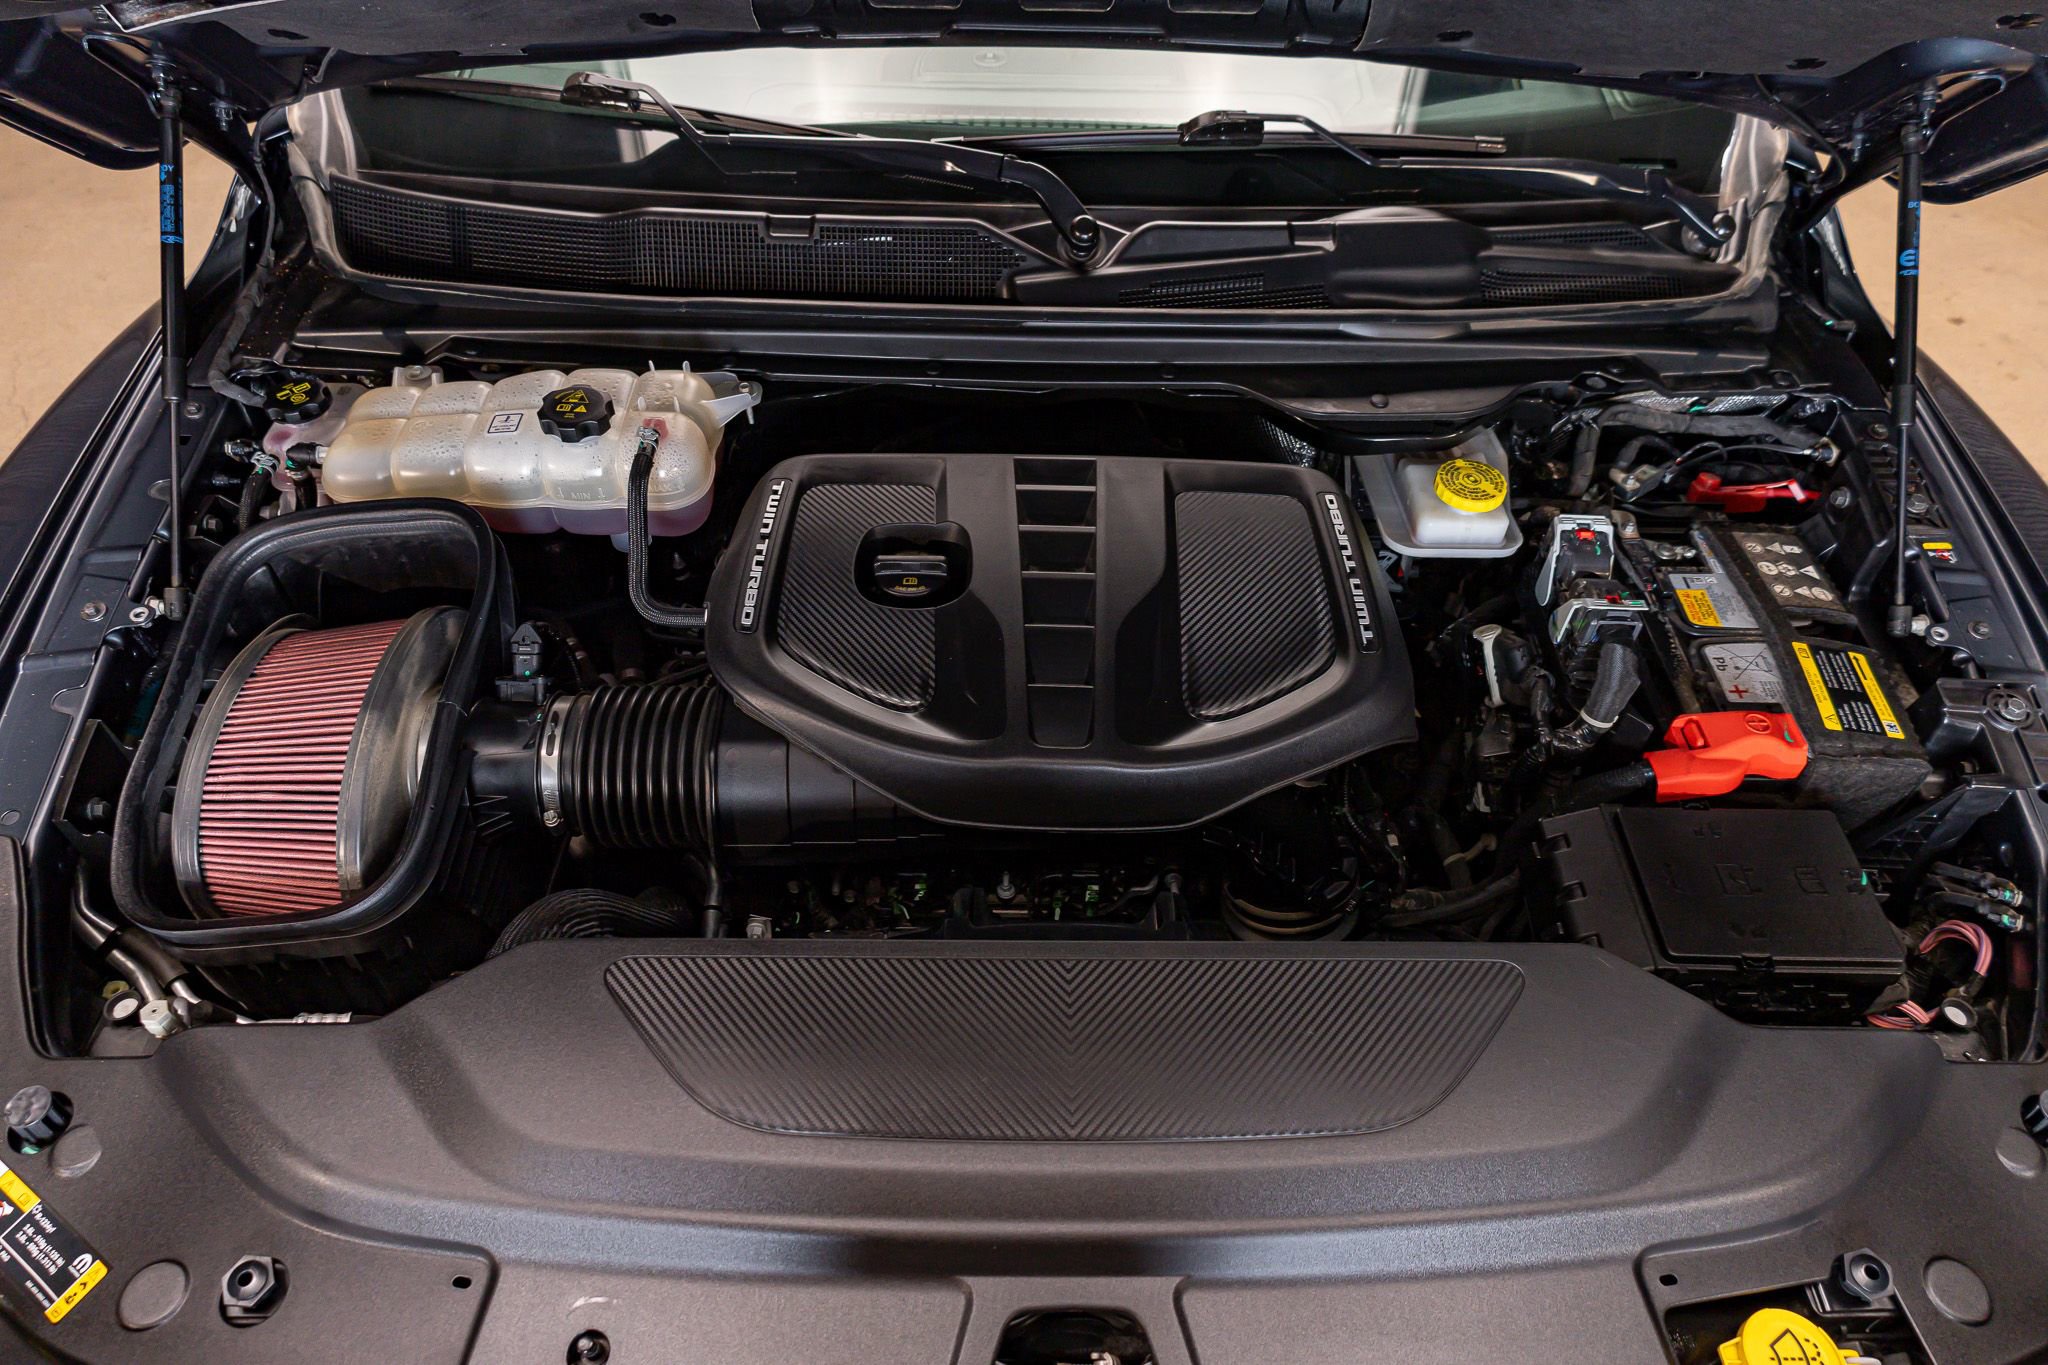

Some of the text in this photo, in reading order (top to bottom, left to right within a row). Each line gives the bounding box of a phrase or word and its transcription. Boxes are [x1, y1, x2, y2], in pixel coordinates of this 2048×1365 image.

[570, 491, 591, 501] MIN
[741, 481, 785, 625] TWIN TURBO
[1324, 494, 1374, 646] TWIN TURBO
